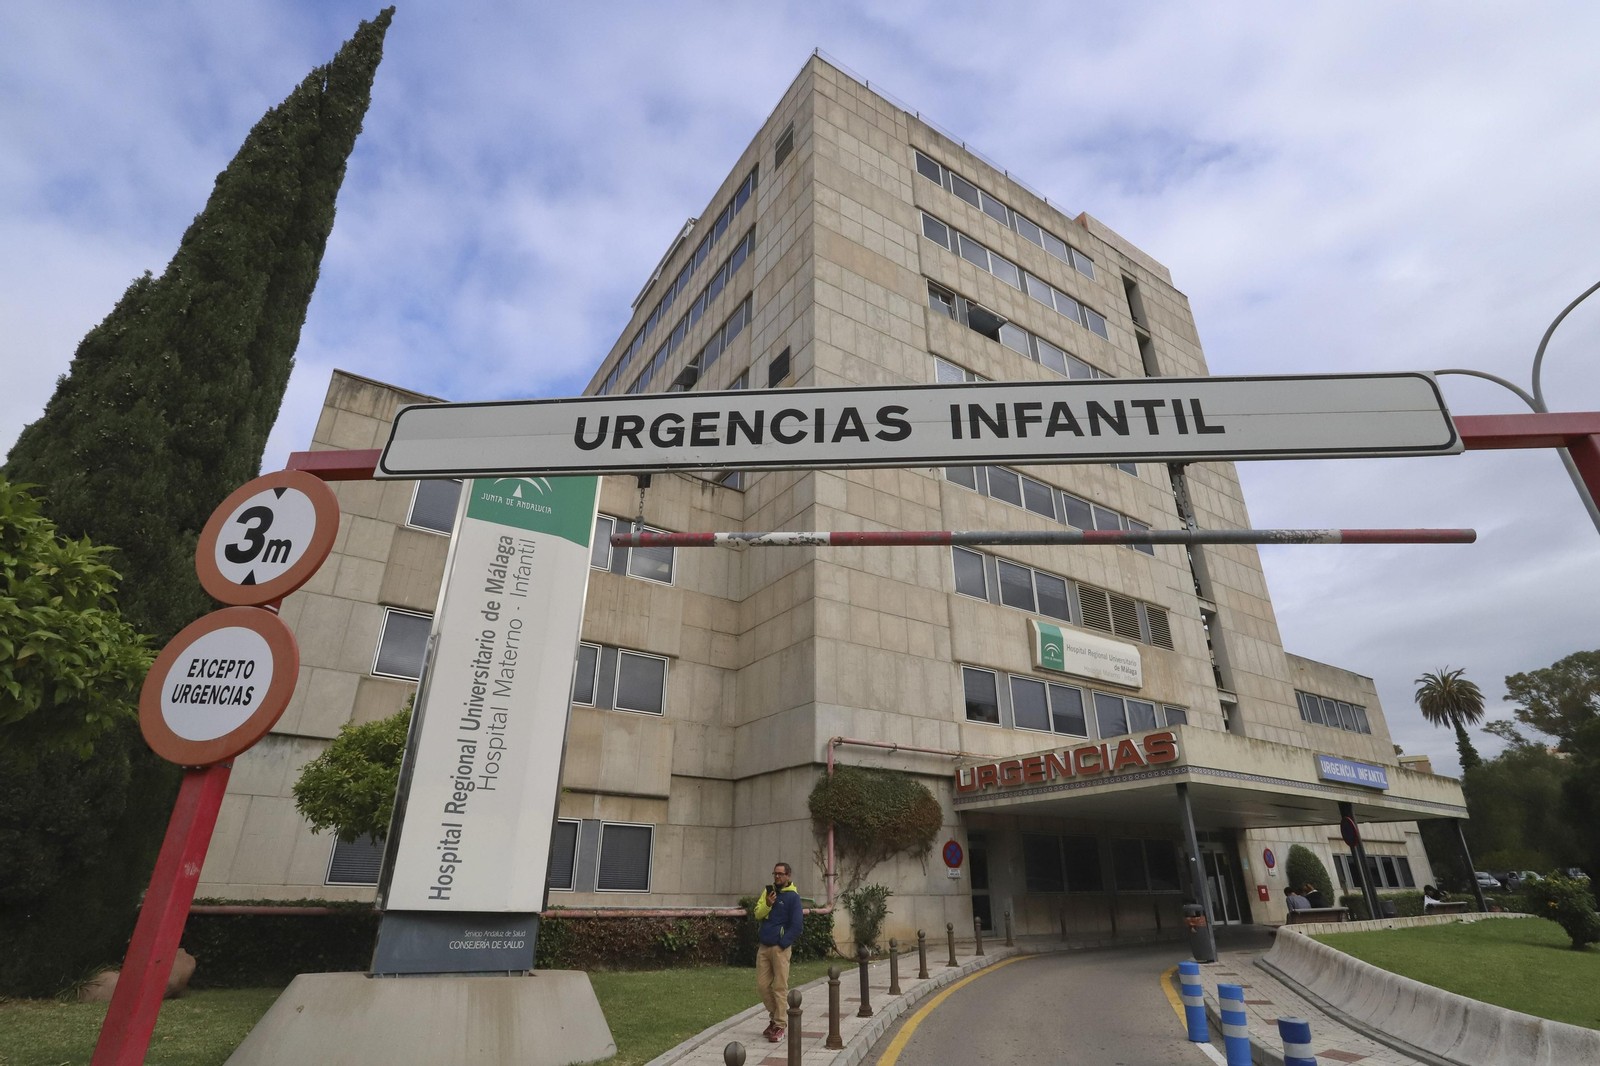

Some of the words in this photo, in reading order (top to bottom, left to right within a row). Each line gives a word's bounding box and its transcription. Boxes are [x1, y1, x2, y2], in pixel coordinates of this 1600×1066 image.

[574, 405, 911, 450] URGENCIAS
[950, 398, 1225, 440] INFANTIL
[481, 492, 503, 504] JUNTA
[505, 497, 514, 507] DE
[485, 534, 516, 595] Málaga
[481, 600, 501, 623] de
[476, 706, 509, 792] Hospital
[493, 617, 524, 698] Materno
[510, 538, 536, 598] Infantil
[1066, 643, 1087, 656] Hospital
[1087, 648, 1108, 660] Regional
[1108, 653, 1137, 667] Universitario
[187, 658, 255, 680] EXCEPTO
[459, 629, 497, 732] Universitario
[1113, 664, 1121, 672] de
[1120, 665, 1138, 677] Málaga
[171, 683, 255, 706] URGENCIAS
[955, 731, 1180, 793] URGENCIAS
[1320, 759, 1357, 779] URGENCIA
[1357, 767, 1387, 785] INFANTIL
[444, 738, 478, 815] Regional
[428, 822, 463, 901] Hospital
[449, 939, 490, 950] CONSEJERÍA
[491, 940, 502, 949] DE
[503, 940, 525, 949] SALUD
[464, 929, 483, 938] Servicio
[483, 930, 504, 938] Andaluz
